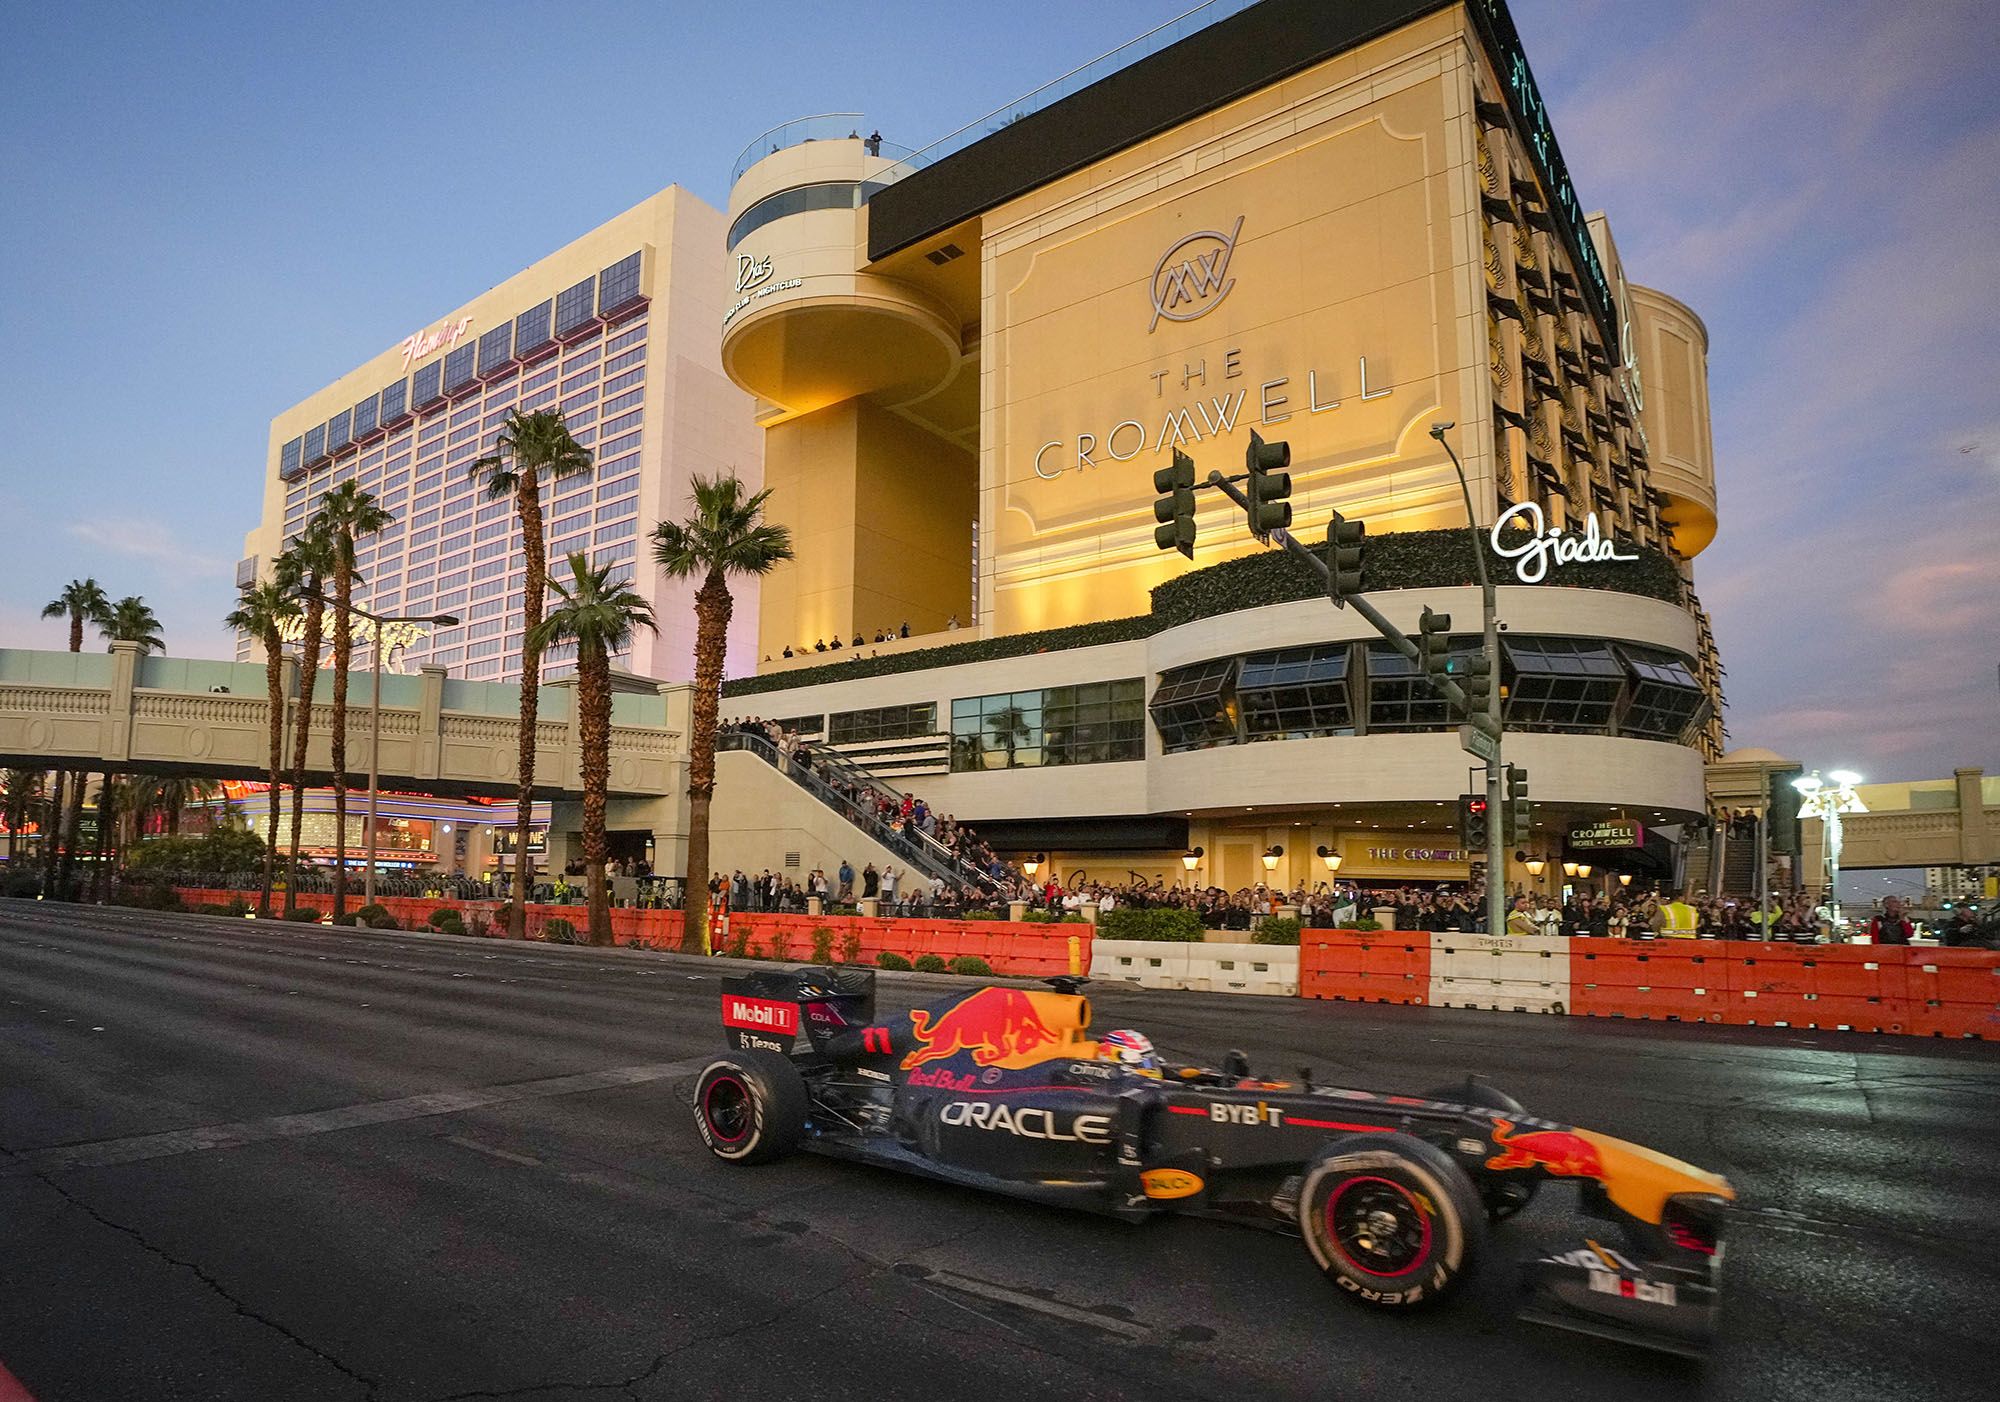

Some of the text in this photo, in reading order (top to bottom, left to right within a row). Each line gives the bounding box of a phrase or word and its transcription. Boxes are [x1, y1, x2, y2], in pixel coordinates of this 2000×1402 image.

[757, 279, 802, 297] NIGHTCLUB
[402, 316, 473, 373] Flamingo
[1150, 349, 1242, 398] THE
[1035, 355, 1393, 480] CROMWELL
[1490, 501, 1639, 583] Giada
[1571, 828, 1634, 838] CROMWELL
[1368, 848, 1398, 859] THE
[733, 1002, 772, 1025] Mobil
[811, 1013, 831, 1022] COLA
[751, 1036, 782, 1053] Tezos
[861, 1027, 893, 1054] 11
[907, 1066, 977, 1091] Red Bull
[940, 1102, 1112, 1144] ORACLE
[1211, 1101, 1284, 1128] BYBIT
[1336, 1274, 1423, 1304] ZERO
